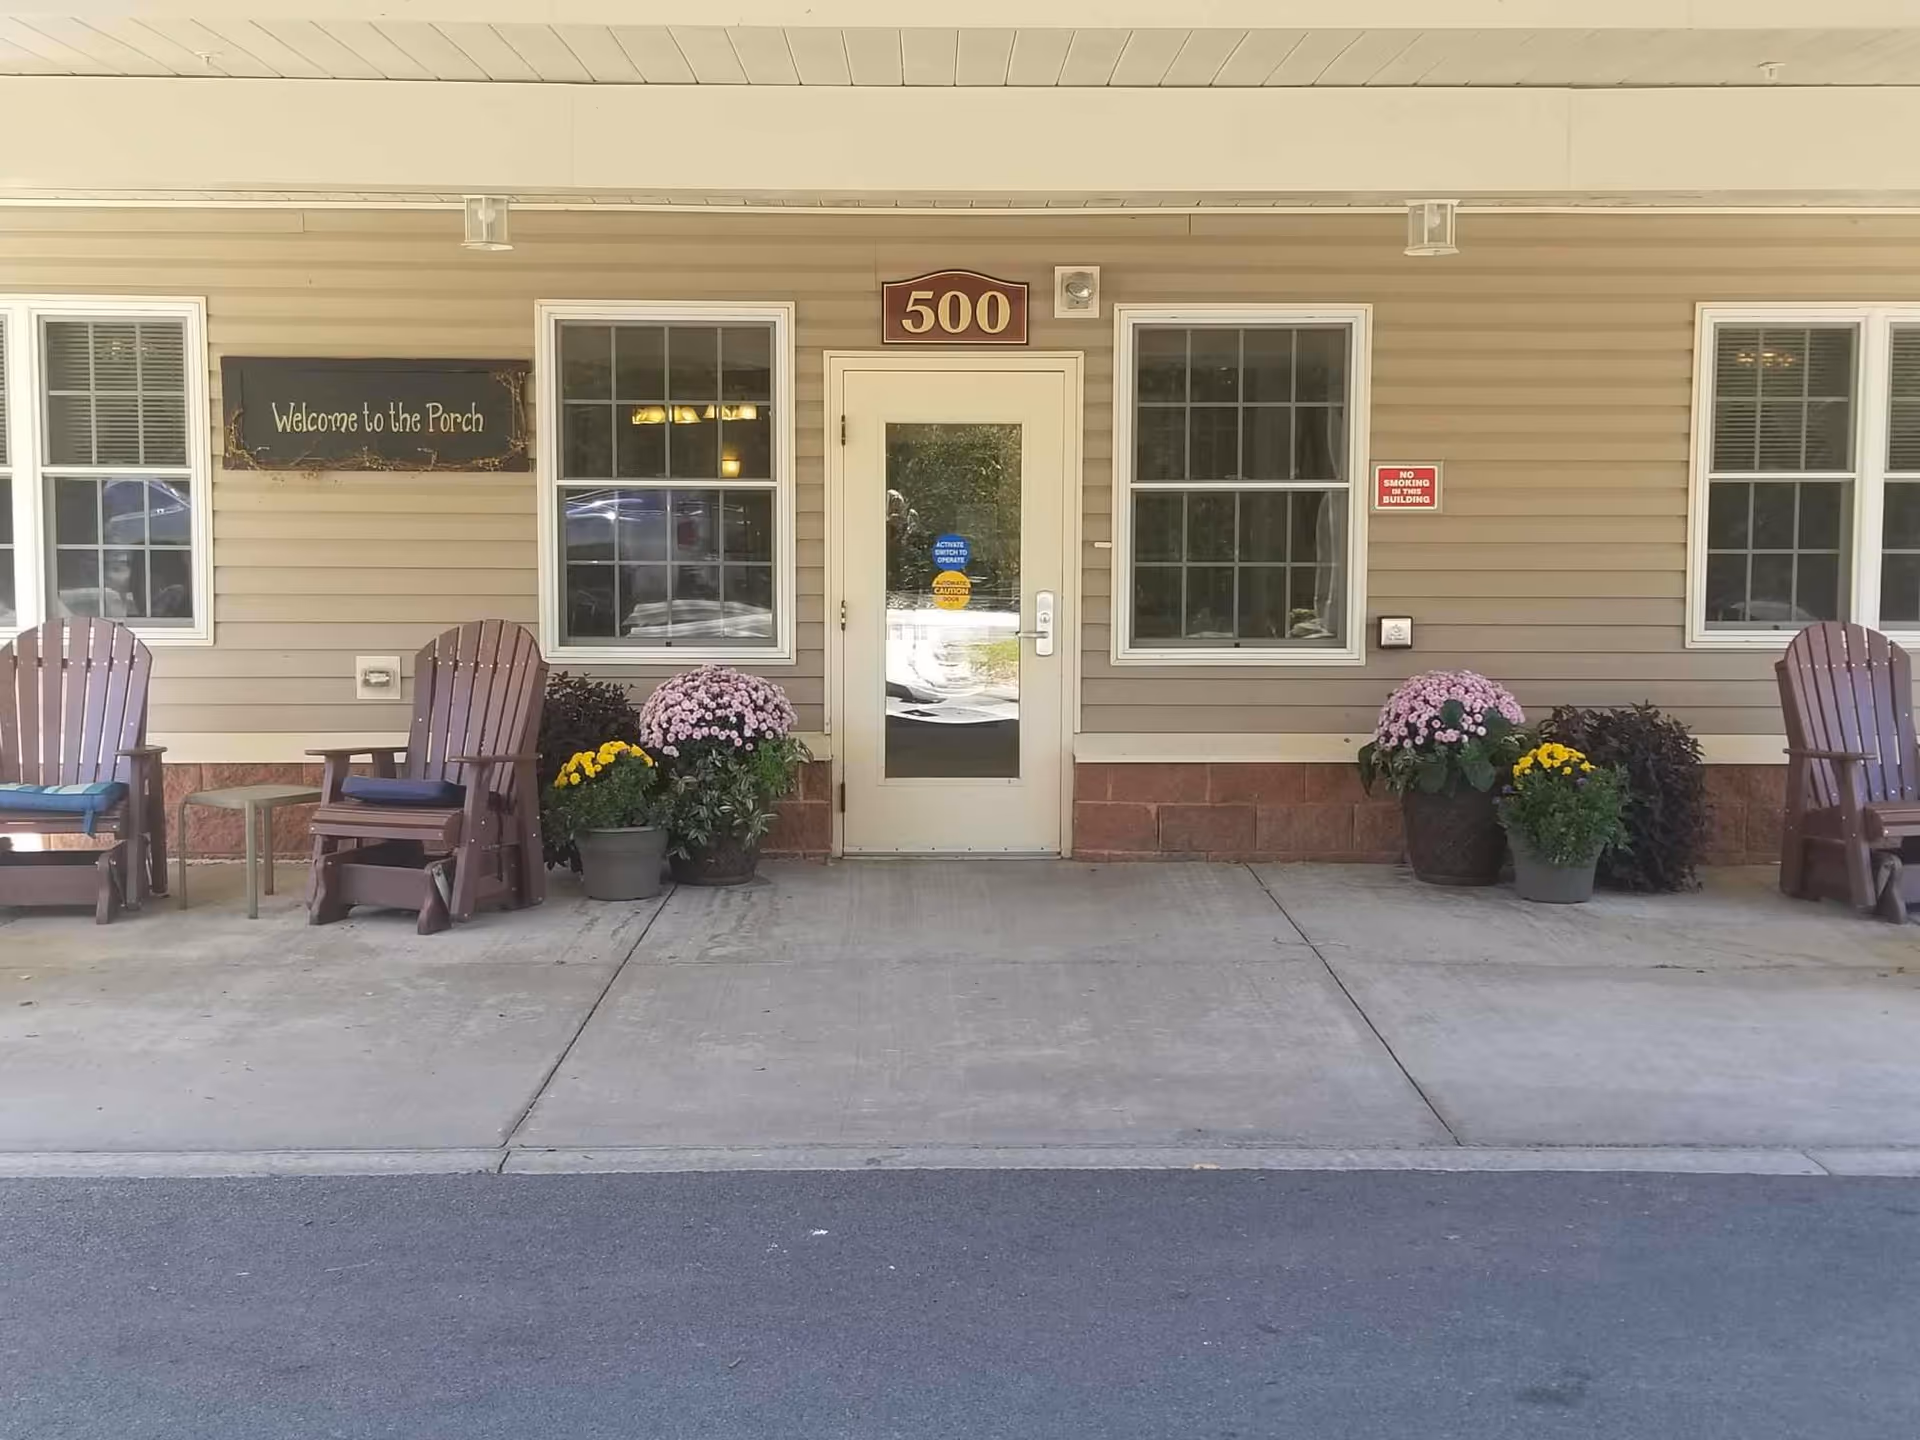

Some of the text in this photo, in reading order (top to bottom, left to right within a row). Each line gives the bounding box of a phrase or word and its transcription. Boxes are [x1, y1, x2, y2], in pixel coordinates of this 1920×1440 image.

[901, 290, 1011, 334] 500
[271, 402, 485, 433] Welcome to the Porch
[1400, 471, 1415, 479] NO
[1383, 479, 1430, 487] SMOKING
[934, 587, 969, 595] CAUTION
